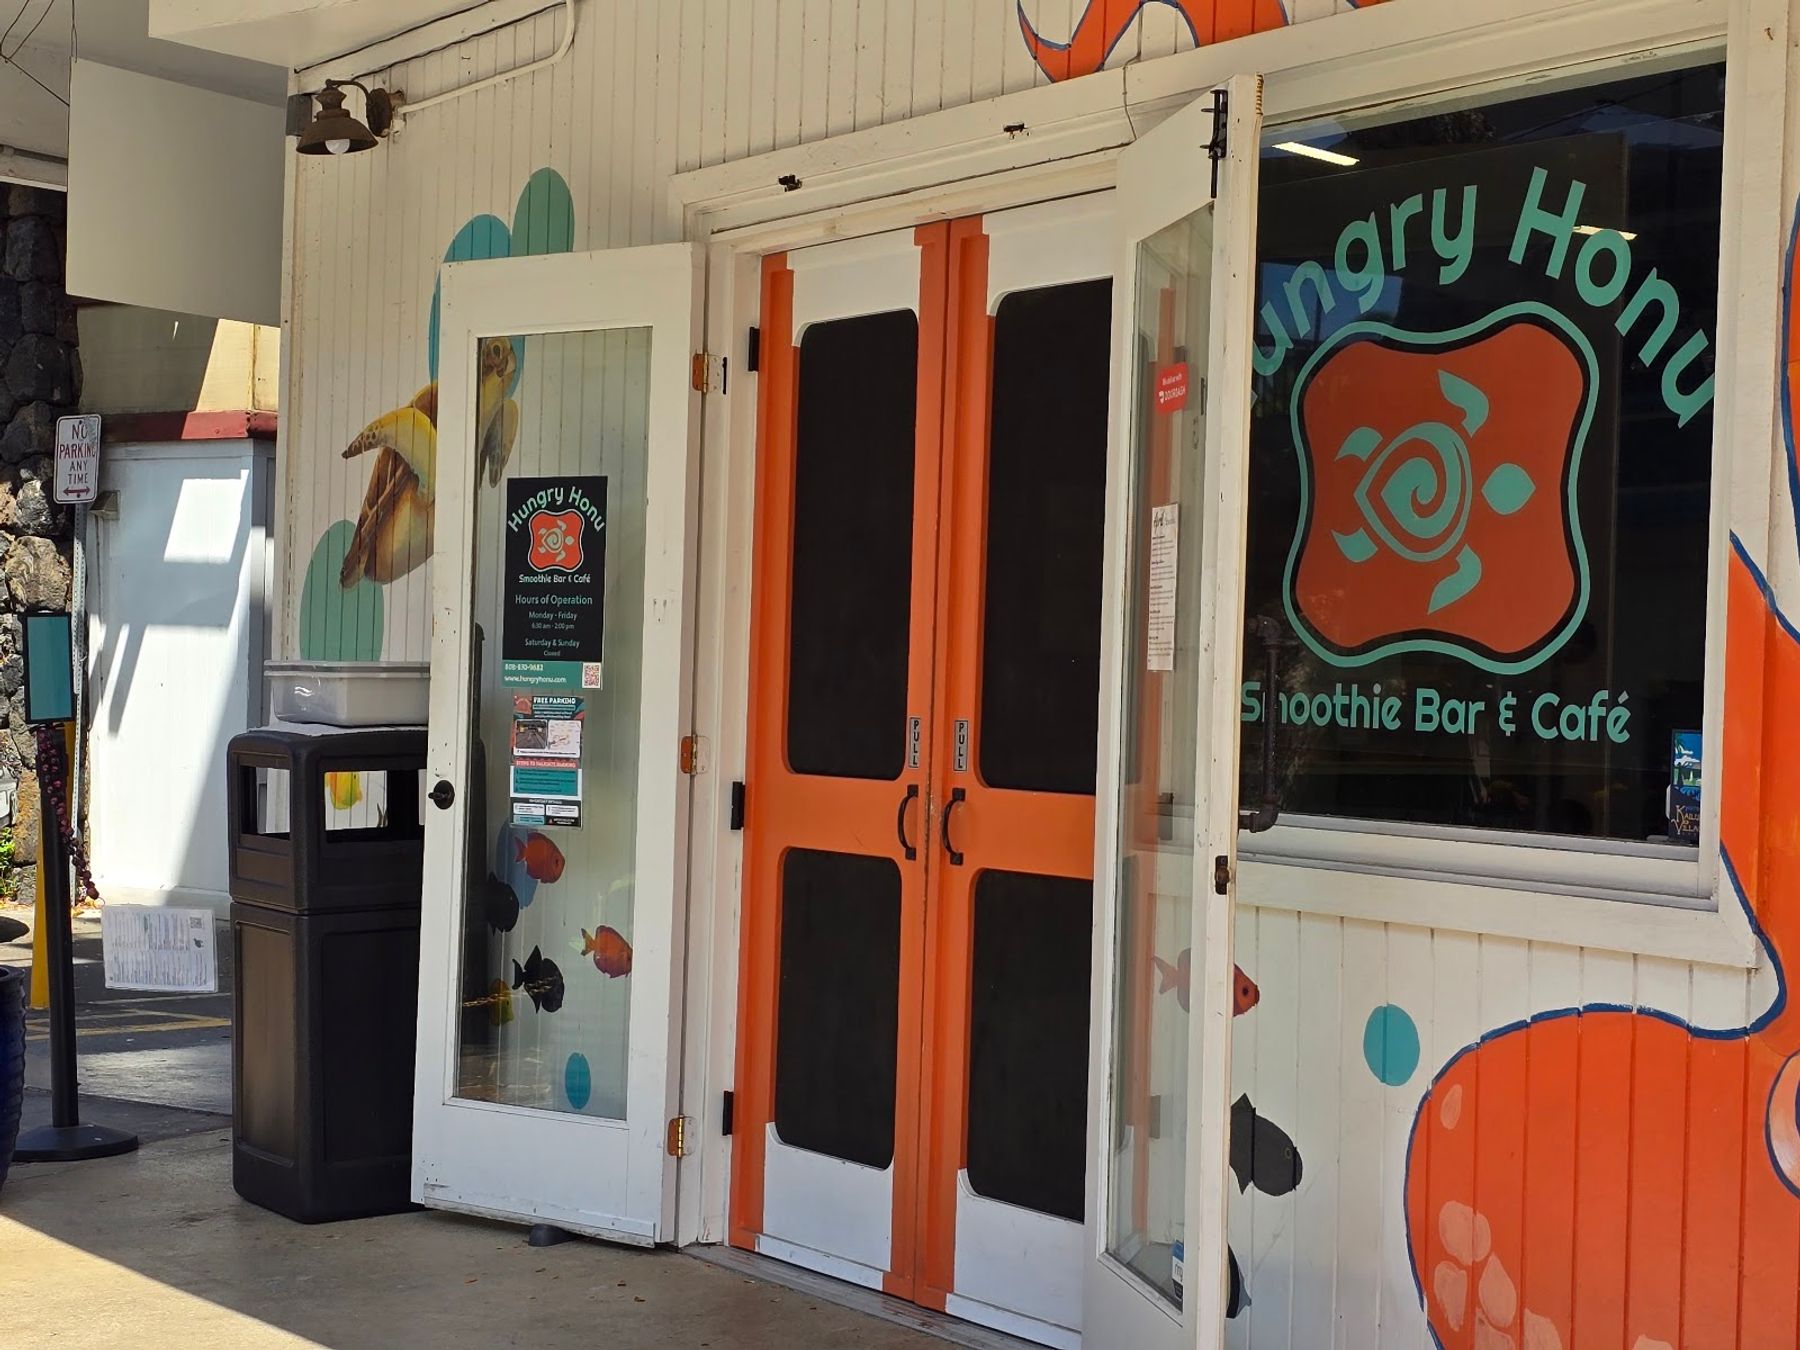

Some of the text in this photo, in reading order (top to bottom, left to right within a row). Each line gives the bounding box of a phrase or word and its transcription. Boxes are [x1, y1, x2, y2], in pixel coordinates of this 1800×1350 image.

[1250, 166, 1715, 428] ungry Honu
[71, 424, 88, 440] NO
[59, 443, 96, 460] PARKING
[69, 460, 88, 472] ANY
[67, 473, 88, 485] TIME
[507, 486, 605, 532] Hungry Honu
[518, 574, 552, 583] Smoothie
[553, 574, 567, 583] Bar
[573, 573, 591, 583] Café
[515, 594, 593, 607] Hours of Operation
[528, 611, 554, 620] Monday
[558, 611, 578, 621] Friday
[525, 638, 552, 648] Saturday
[558, 639, 580, 649] Sunday
[504, 675, 567, 684] www.hungryhonu.com
[549, 697, 576, 705] PARKING
[1414, 687, 1486, 736] Bar
[1499, 690, 1517, 738] &
[1531, 689, 1632, 744] Café
[912, 720, 920, 766] PULL
[957, 722, 965, 769] PULL
